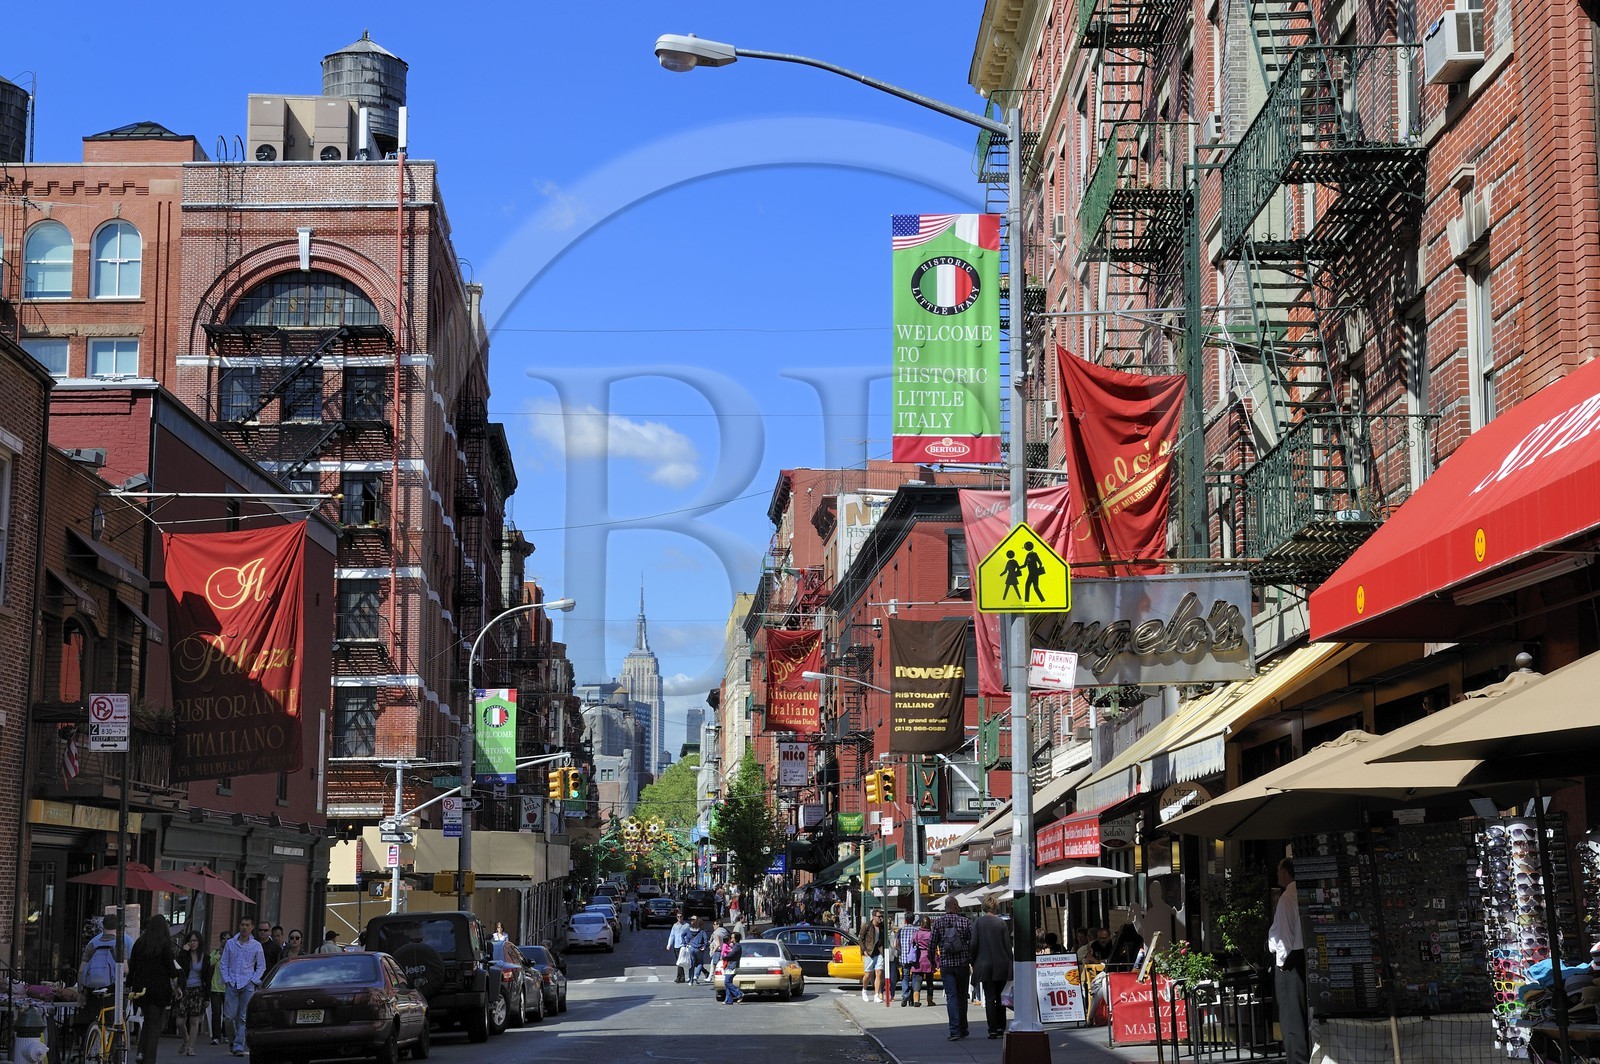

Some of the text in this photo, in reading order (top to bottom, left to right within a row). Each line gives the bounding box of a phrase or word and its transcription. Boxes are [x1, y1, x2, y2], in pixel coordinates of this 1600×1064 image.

[920, 257, 973, 274] HISTORIC
[912, 285, 980, 315] LITTLE ITALY
[896, 324, 992, 341] WELCOME
[897, 346, 919, 363] TO
[898, 368, 988, 384] HISTORIC
[898, 391, 964, 407] LITTLE
[898, 412, 954, 429] ITALY
[1113, 479, 1158, 514] of MULBERRY
[975, 500, 1007, 518] Caffé
[205, 557, 267, 610] Il
[172, 631, 297, 683] Palazzo
[1032, 651, 1073, 665] NO PARKING
[770, 657, 795, 684] Da
[895, 664, 965, 679] novella
[768, 687, 818, 701] Ristorante
[174, 687, 297, 723] RISTORANTE
[770, 703, 815, 717] Italiano
[91, 724, 98, 735] 2
[802, 718, 818, 726] Dining
[186, 725, 285, 757] ITALIANO
[477, 731, 514, 739] WELCOME
[782, 751, 805, 761] NICO
[196, 759, 251, 776] MULBERRY
[478, 765, 499, 773] ITALY
[1174, 788, 1199, 797] Pizza
[523, 797, 535, 806] LA
[524, 802, 541, 813] MELA
[1103, 827, 1126, 838] Salads
[405, 964, 426, 974] Jeep
